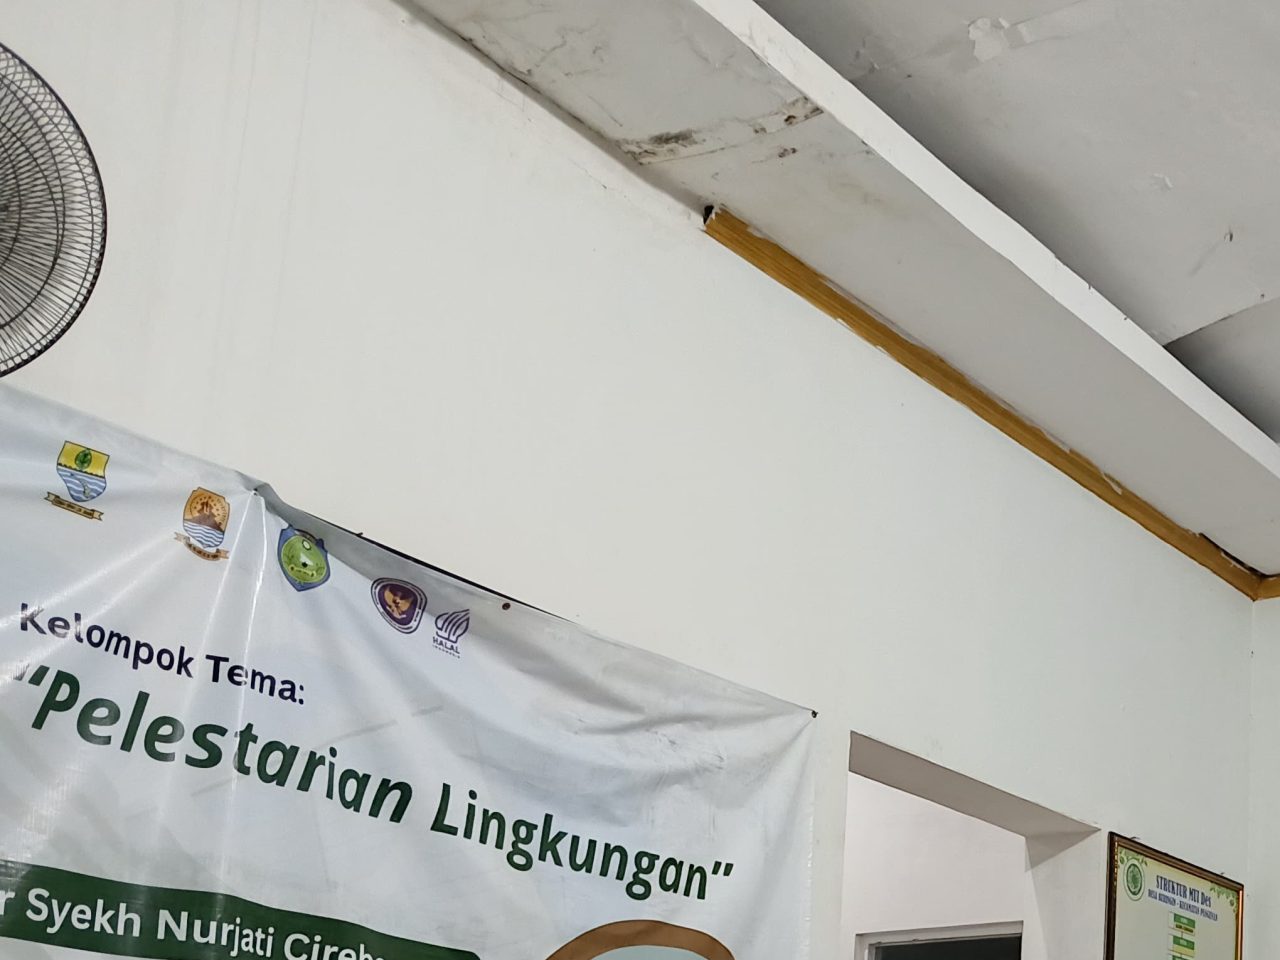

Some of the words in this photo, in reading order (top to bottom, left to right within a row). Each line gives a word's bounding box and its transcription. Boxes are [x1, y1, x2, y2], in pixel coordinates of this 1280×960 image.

[20, 603, 194, 678] Kelompok
[205, 654, 304, 705] Tema:
[433, 636, 460, 654] HALAL
[1155, 875, 1188, 899] STRUKTUR
[26, 888, 141, 937] Syekh
[157, 909, 274, 957] Nurjati
